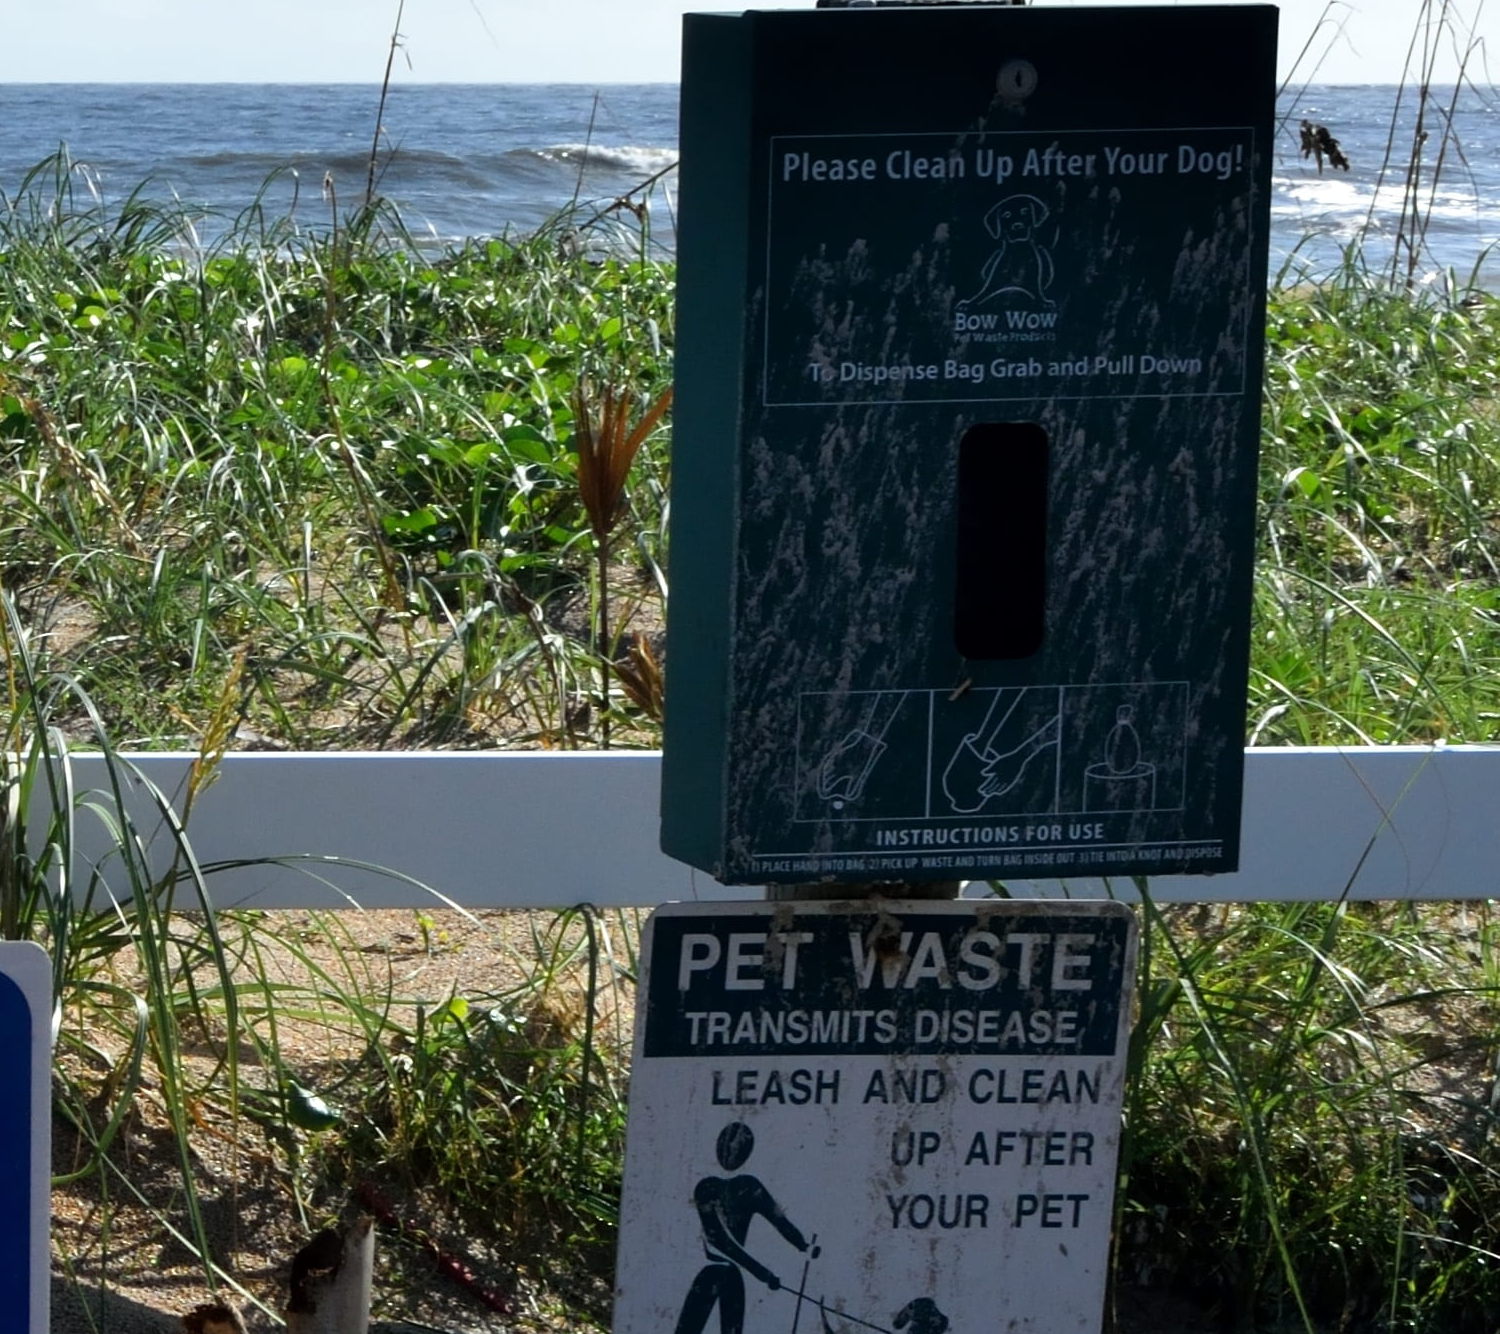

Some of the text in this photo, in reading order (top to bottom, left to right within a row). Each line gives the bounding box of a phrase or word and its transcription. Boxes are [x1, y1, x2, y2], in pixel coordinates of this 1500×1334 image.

[783, 144, 1242, 183] Please Clean Up After Your Dog!
[953, 309, 1057, 331] Bow Wow
[810, 354, 1202, 386] To Dispense Bag Grab and Pull Down
[876, 822, 1103, 846] INSTRUCTIONS FOR USE
[678, 932, 1095, 990] PET WASTE
[685, 1011, 1079, 1044] TRANSMITS DISEASE
[711, 1068, 1101, 1105] LEASH AND CLEAN
[890, 1131, 1094, 1167] UP AFTER
[886, 1193, 1089, 1229] YOUR PET
